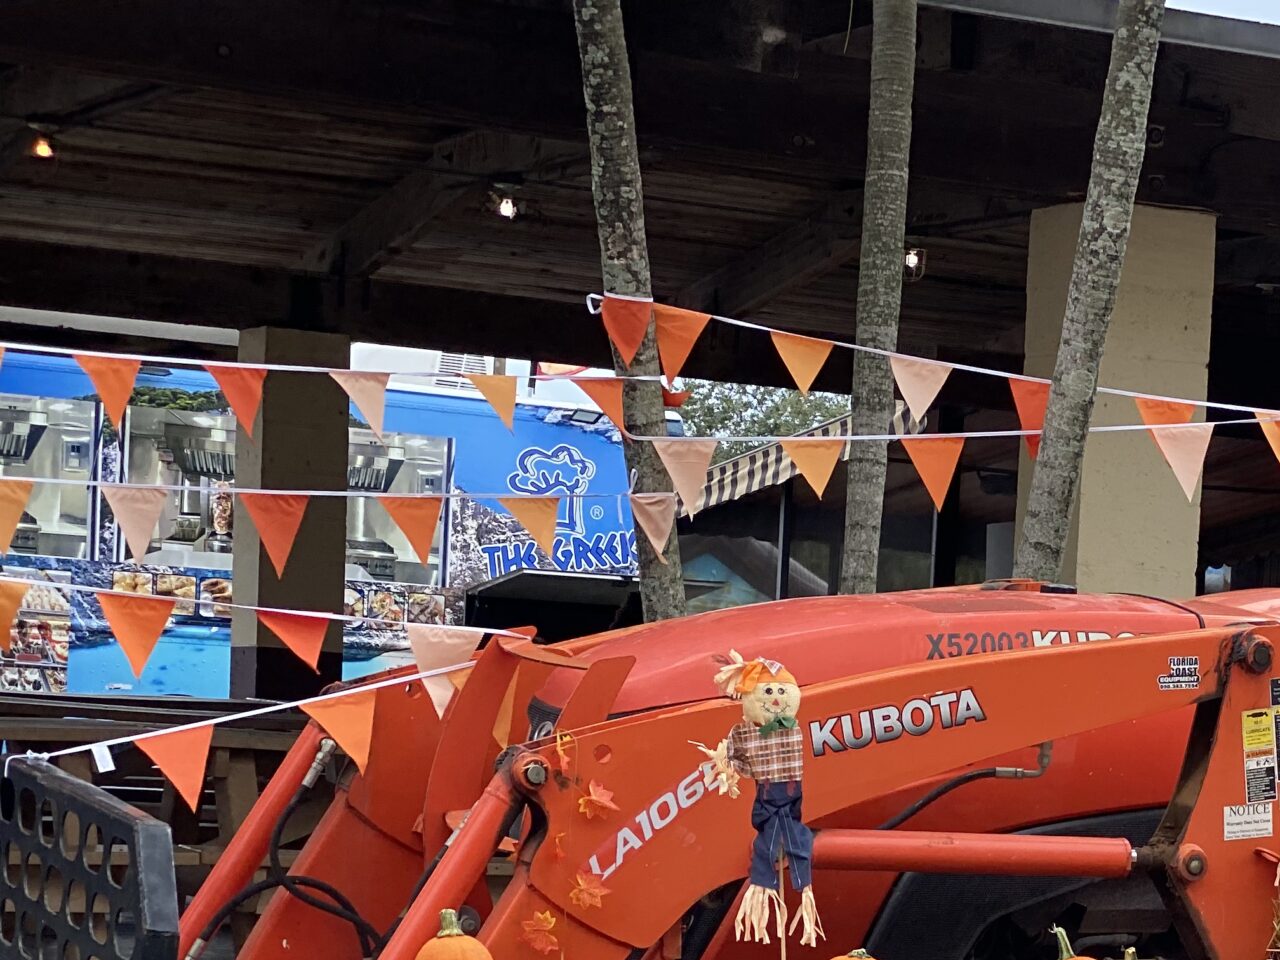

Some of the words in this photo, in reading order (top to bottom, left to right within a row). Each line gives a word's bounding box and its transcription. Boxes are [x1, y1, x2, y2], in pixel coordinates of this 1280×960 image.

[481, 541, 538, 579] THE
[926, 631, 1029, 660] X52003
[1168, 656, 1198, 667] FLORIDA
[809, 687, 987, 757] KUBOTA
[1229, 803, 1271, 817] NOTICE
